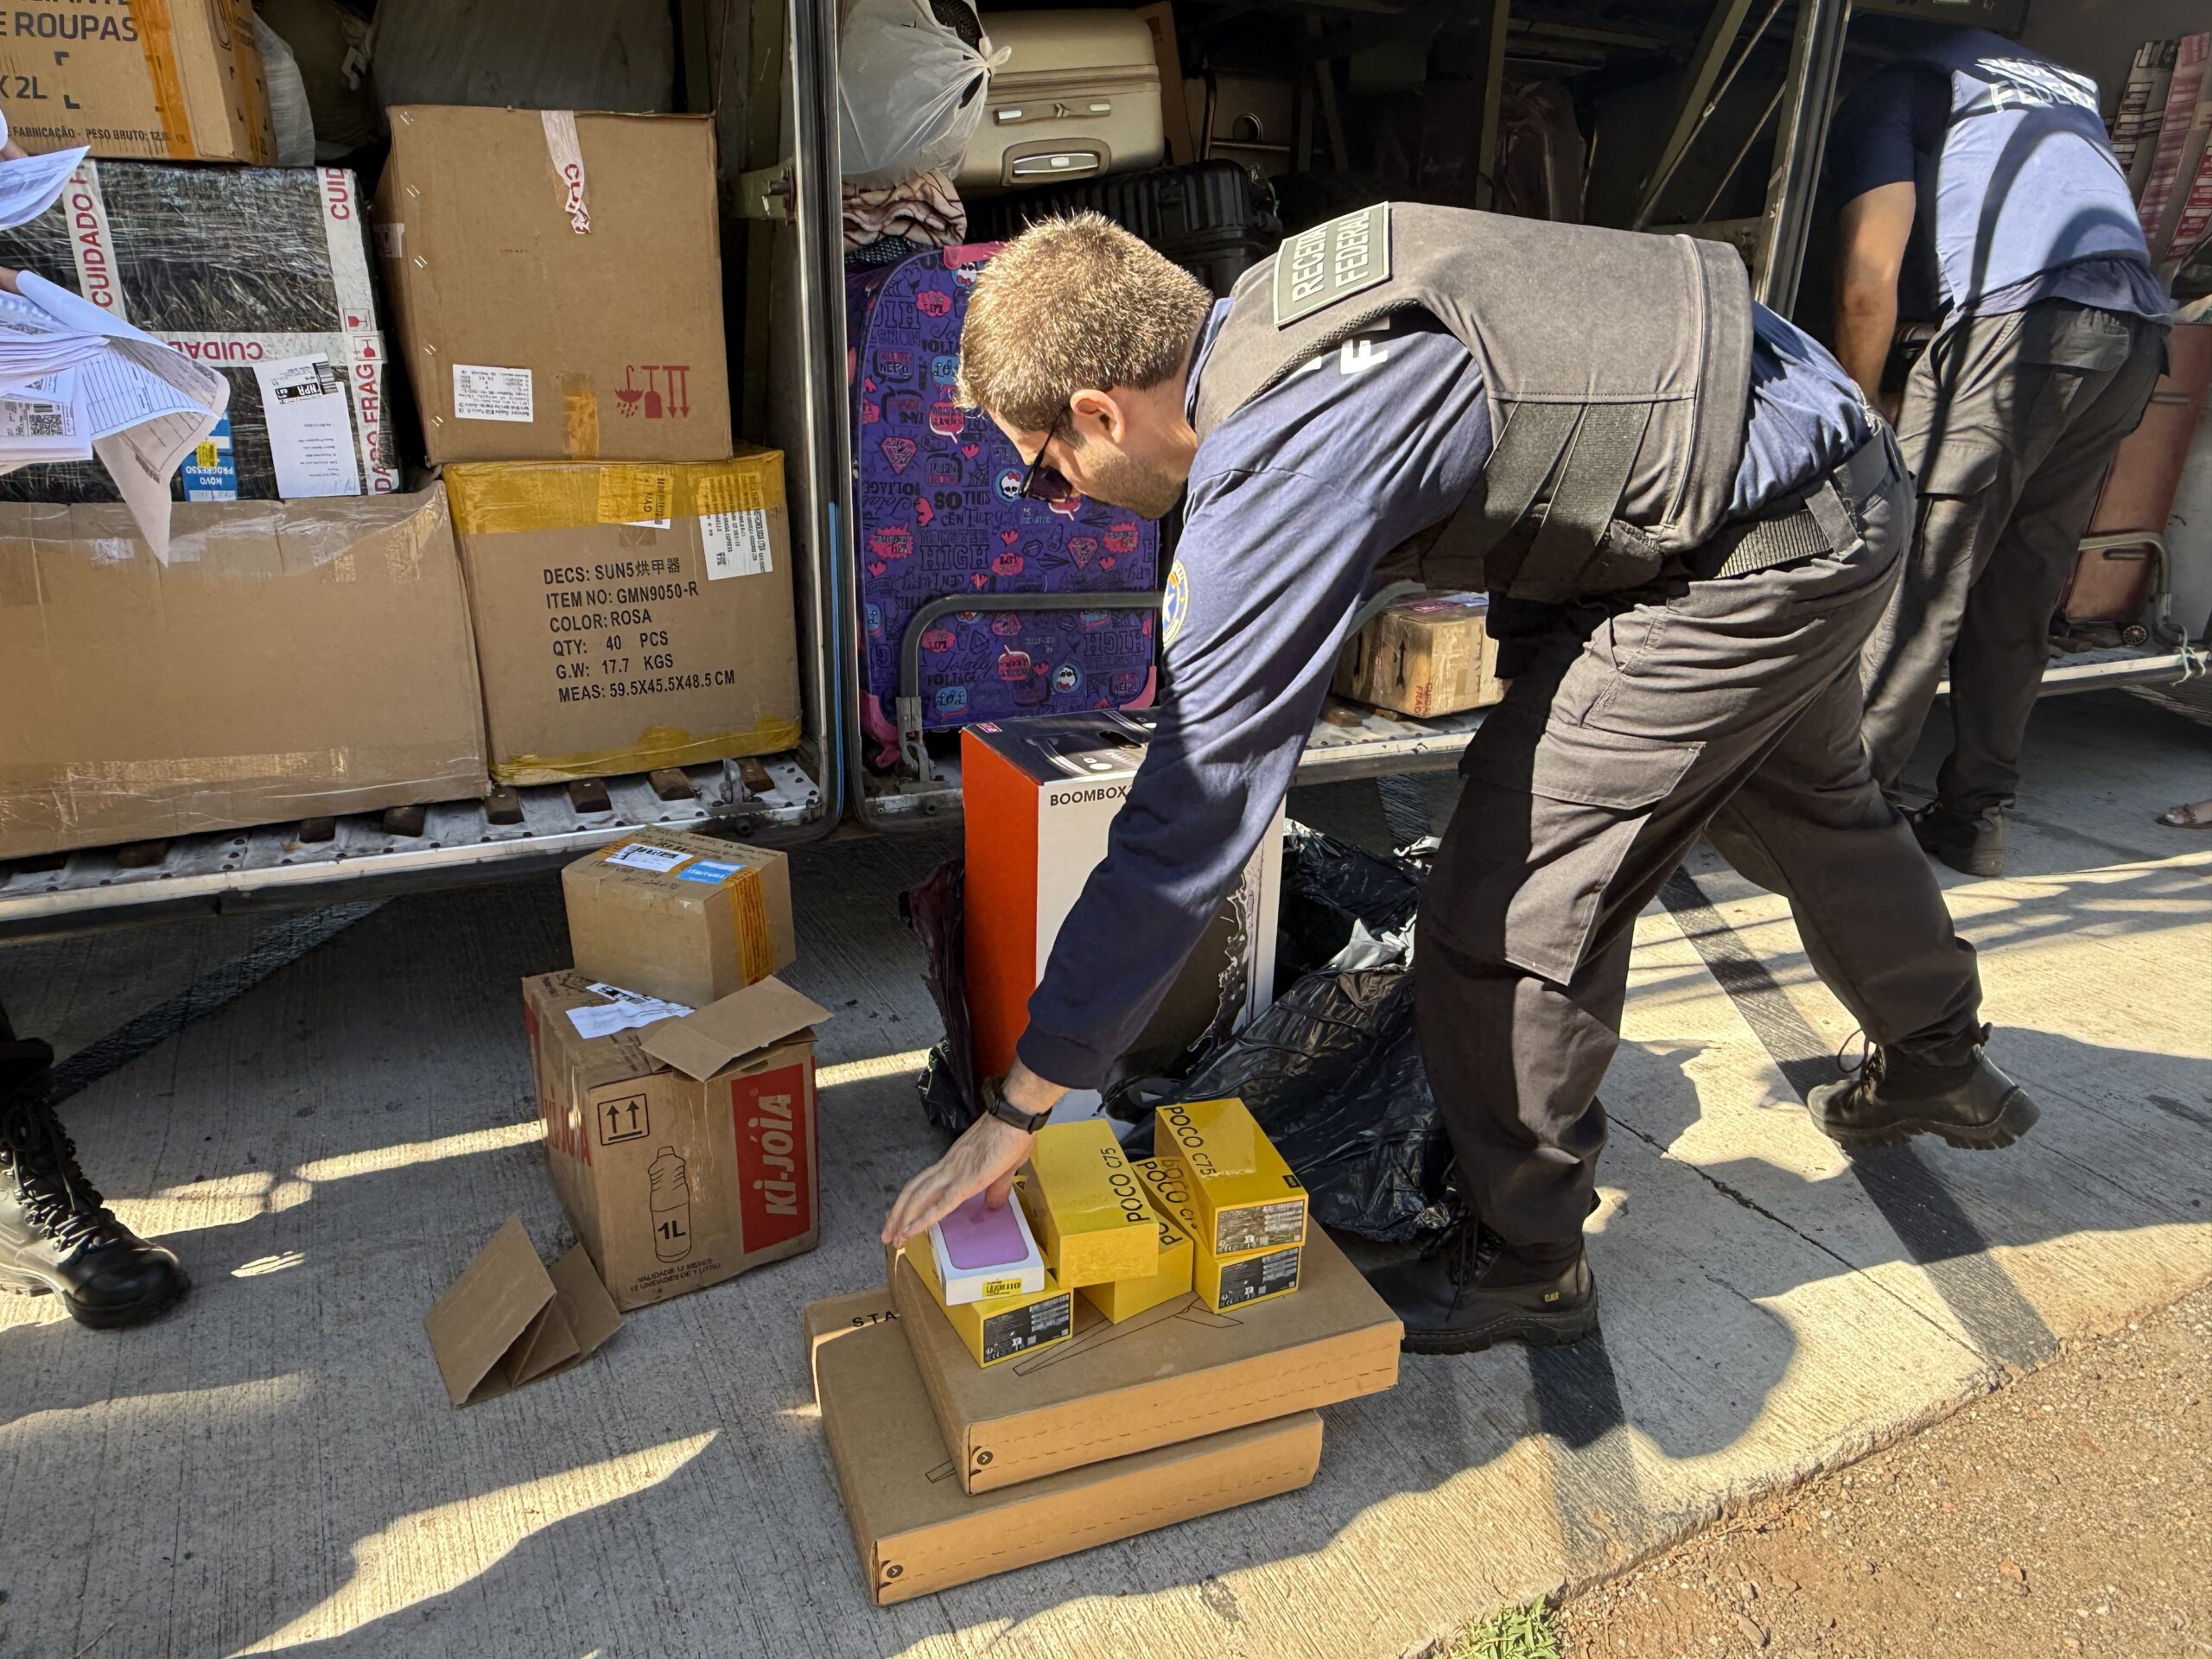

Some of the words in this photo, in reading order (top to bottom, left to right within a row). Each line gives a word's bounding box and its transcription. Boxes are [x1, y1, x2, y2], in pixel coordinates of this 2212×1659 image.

[15, 11, 138, 41] ROUPAS
[16, 75, 48, 99] 2L
[86, 130, 111, 139] PESO
[72, 194, 114, 308] CUIDADO
[1335, 210, 1371, 289] FEDERAL
[1292, 226, 1328, 302] RECEITA
[186, 466, 234, 475] PROGRESSO
[200, 477, 222, 486] NOVO
[920, 544, 990, 571] HIGH
[543, 567, 590, 586] DECS:
[546, 590, 583, 610] ITEM
[586, 590, 613, 607] NO:
[616, 581, 699, 606] GMN9050-R
[550, 612, 607, 633] COLOR:
[610, 608, 652, 627] ROSA
[552, 639, 588, 658] QTY:
[606, 634, 622, 652] 40
[639, 631, 669, 649] PCS
[556, 663, 589, 681] G.W:
[601, 658, 630, 676] 17.7
[643, 653, 674, 672] KGS
[558, 683, 606, 703] MEAS:
[715, 670, 735, 687] CM
[1050, 785, 1128, 806] BOOMBOX
[1163, 1106, 1205, 1148] POCO
[1192, 1153, 1217, 1176] C75
[1100, 1147, 1122, 1168] C75
[1136, 1160, 1185, 1205] POCO
[1109, 1173, 1151, 1223] POCO
[658, 1221, 686, 1240] 1L
[852, 1310, 898, 1328] STA
